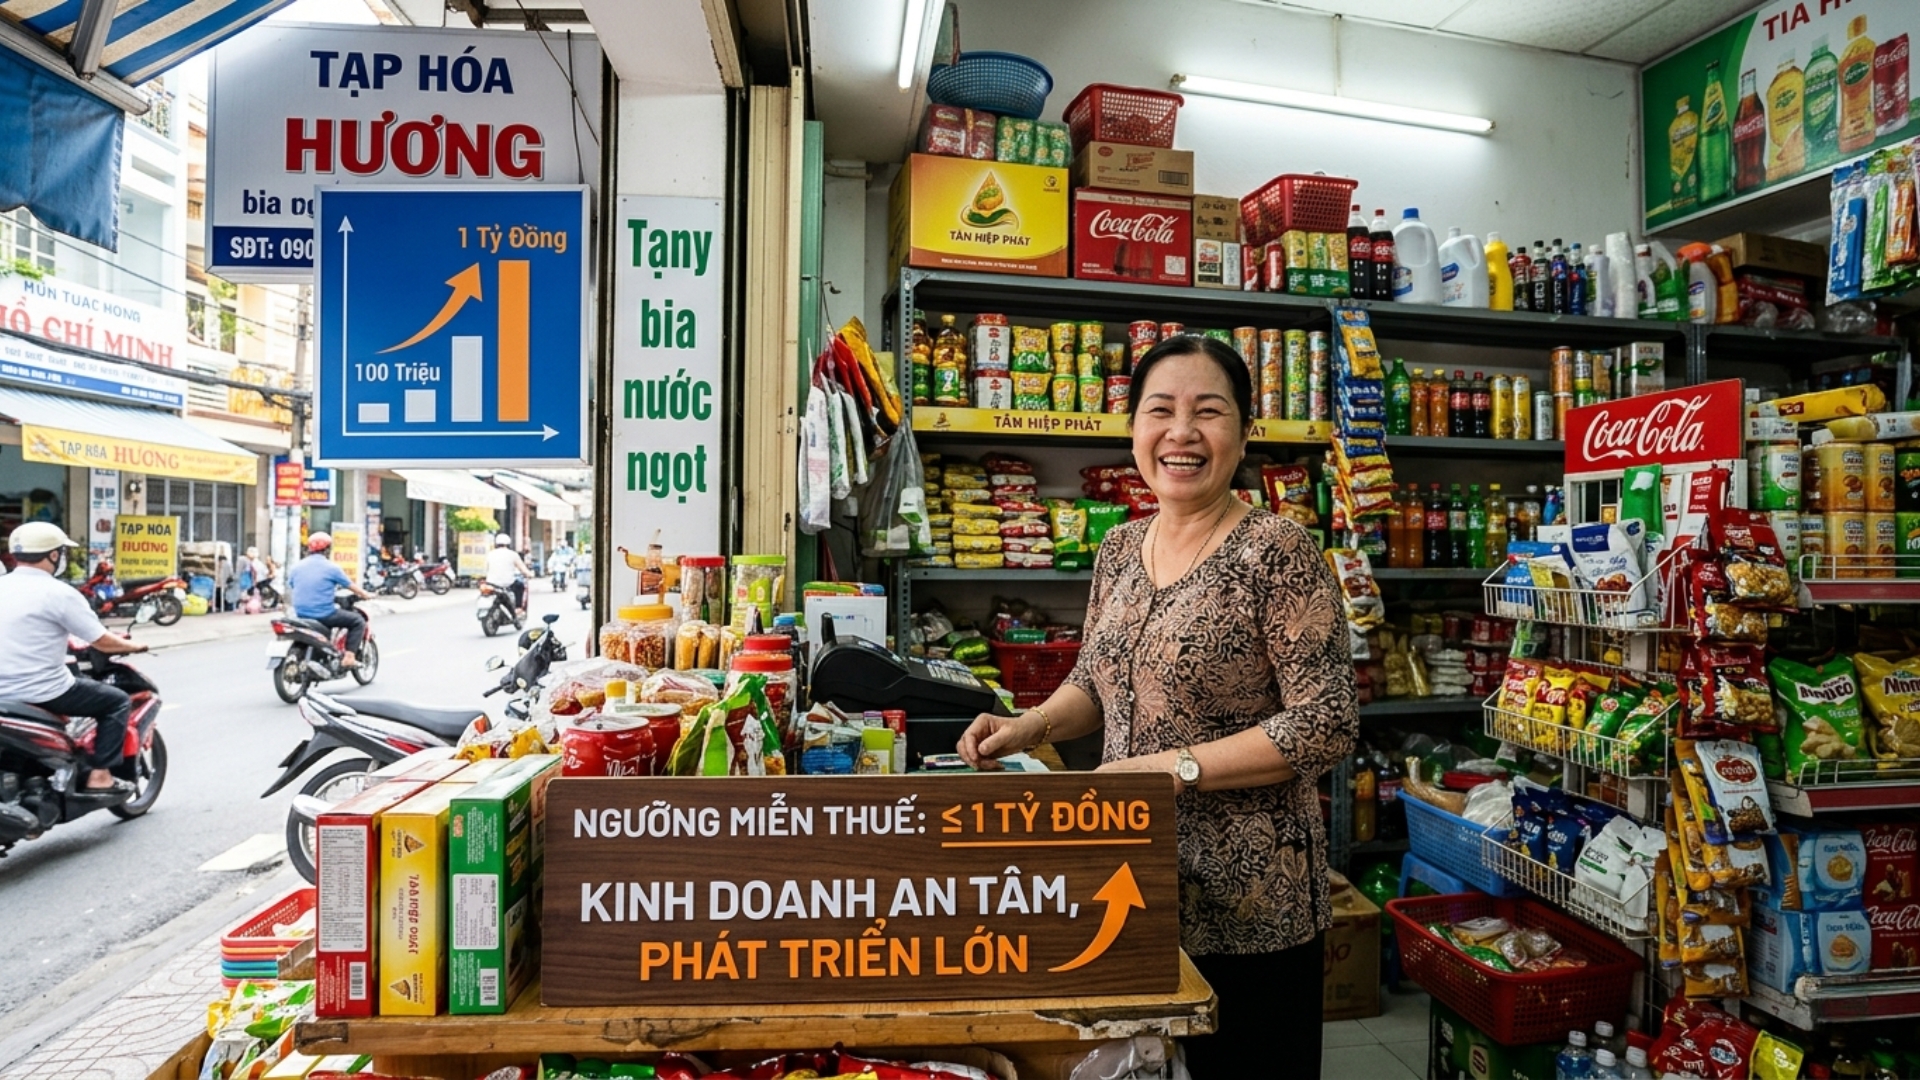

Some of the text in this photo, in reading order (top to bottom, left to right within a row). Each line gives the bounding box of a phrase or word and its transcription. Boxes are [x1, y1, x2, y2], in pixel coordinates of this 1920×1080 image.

[1762, 3, 1811, 41] TIA
[311, 45, 514, 98] TẠP HÓA
[285, 110, 543, 179] HƯƠNG
[242, 189, 282, 215] bia
[230, 236, 274, 259] SĐT:
[458, 227, 467, 248] 1
[476, 223, 504, 254] Tỷ
[627, 218, 713, 280] Tạny
[640, 298, 697, 349] bia
[355, 362, 440, 385] 100 Triệu
[623, 368, 712, 421] nước
[1582, 393, 1713, 462] Coca-Cola
[626, 444, 707, 504] ngọt
[574, 800, 720, 838] NGƯỠNG
[730, 792, 813, 836] MIỄN
[823, 794, 926, 835] THUẾ:
[994, 791, 1040, 833] TỶ
[1051, 788, 1150, 832] ĐỒNG
[580, 865, 1079, 922] KINH DOANH AN TÂM,
[640, 918, 1028, 981] PHÁT TRIỂN LỚN
